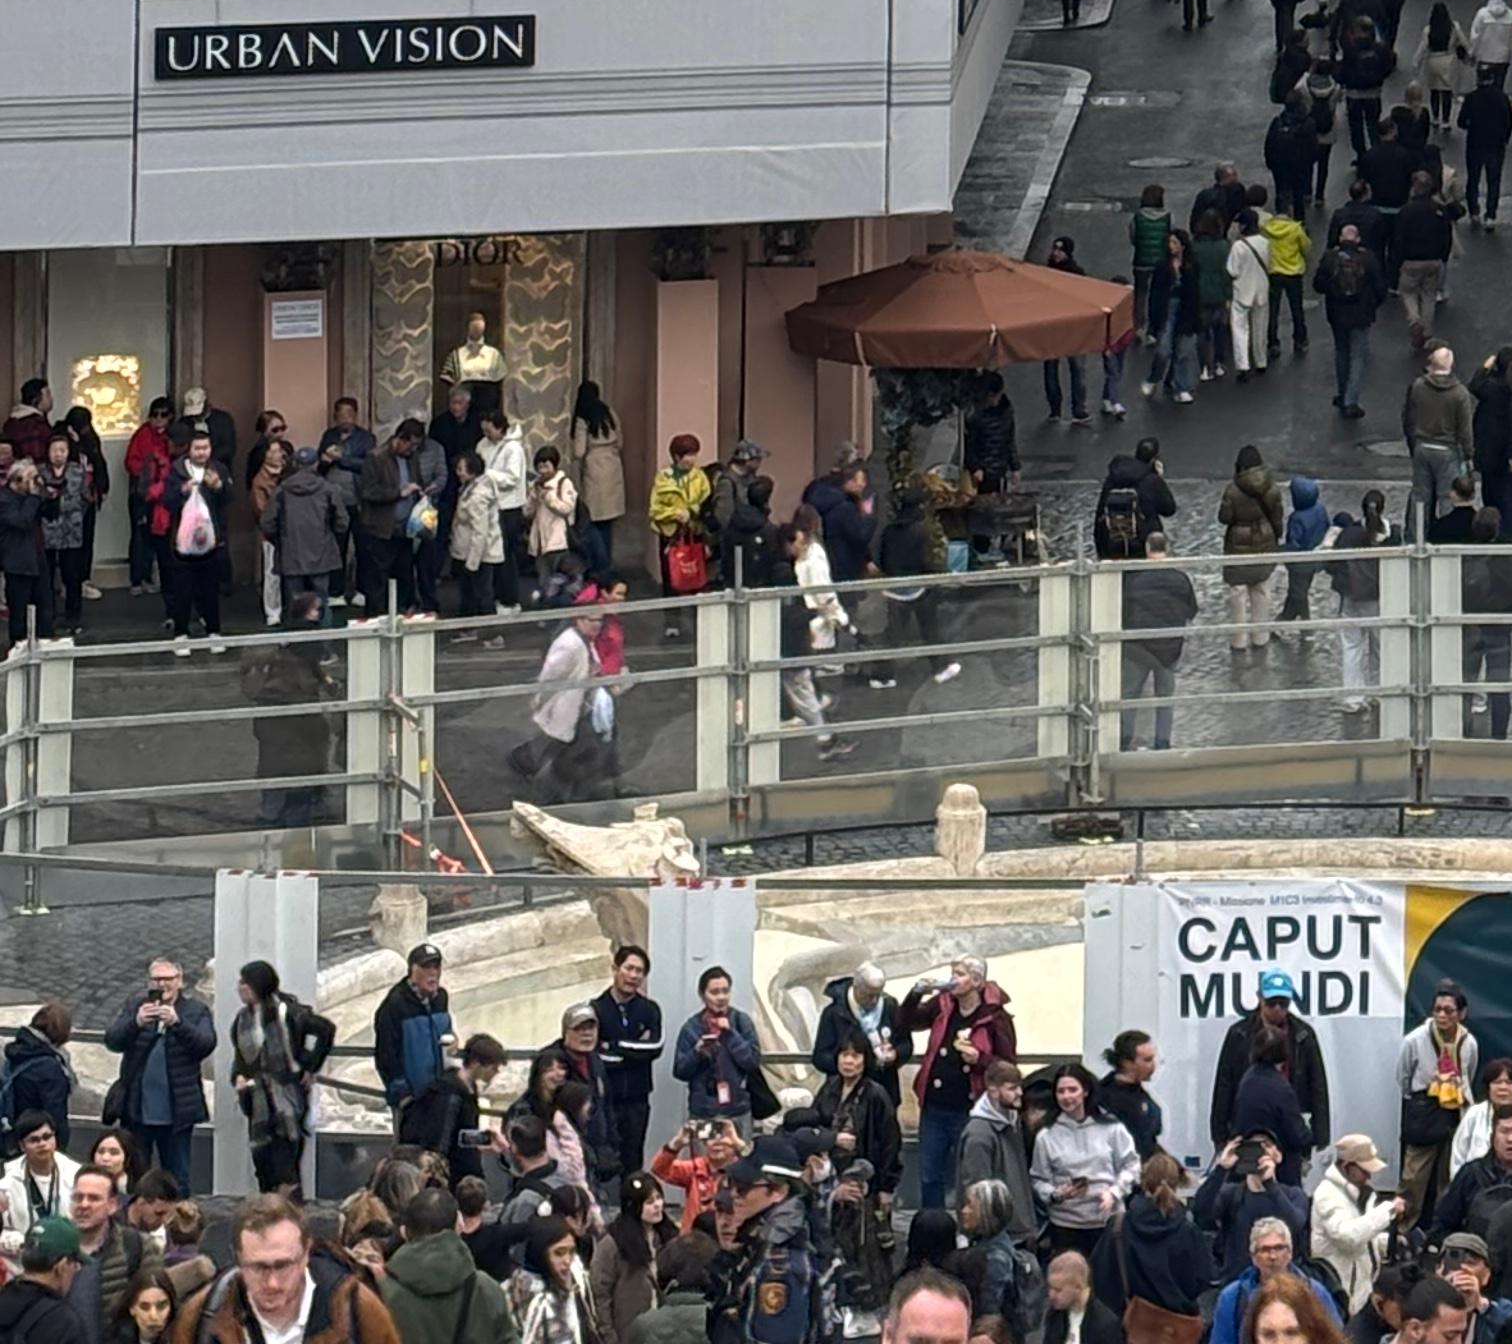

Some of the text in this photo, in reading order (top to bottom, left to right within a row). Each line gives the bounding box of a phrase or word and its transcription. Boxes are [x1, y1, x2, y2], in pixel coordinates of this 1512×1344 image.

[167, 23, 524, 72] URBAN VISION
[435, 239, 525, 268] DIOR
[1178, 914, 1382, 963] CAPUT
